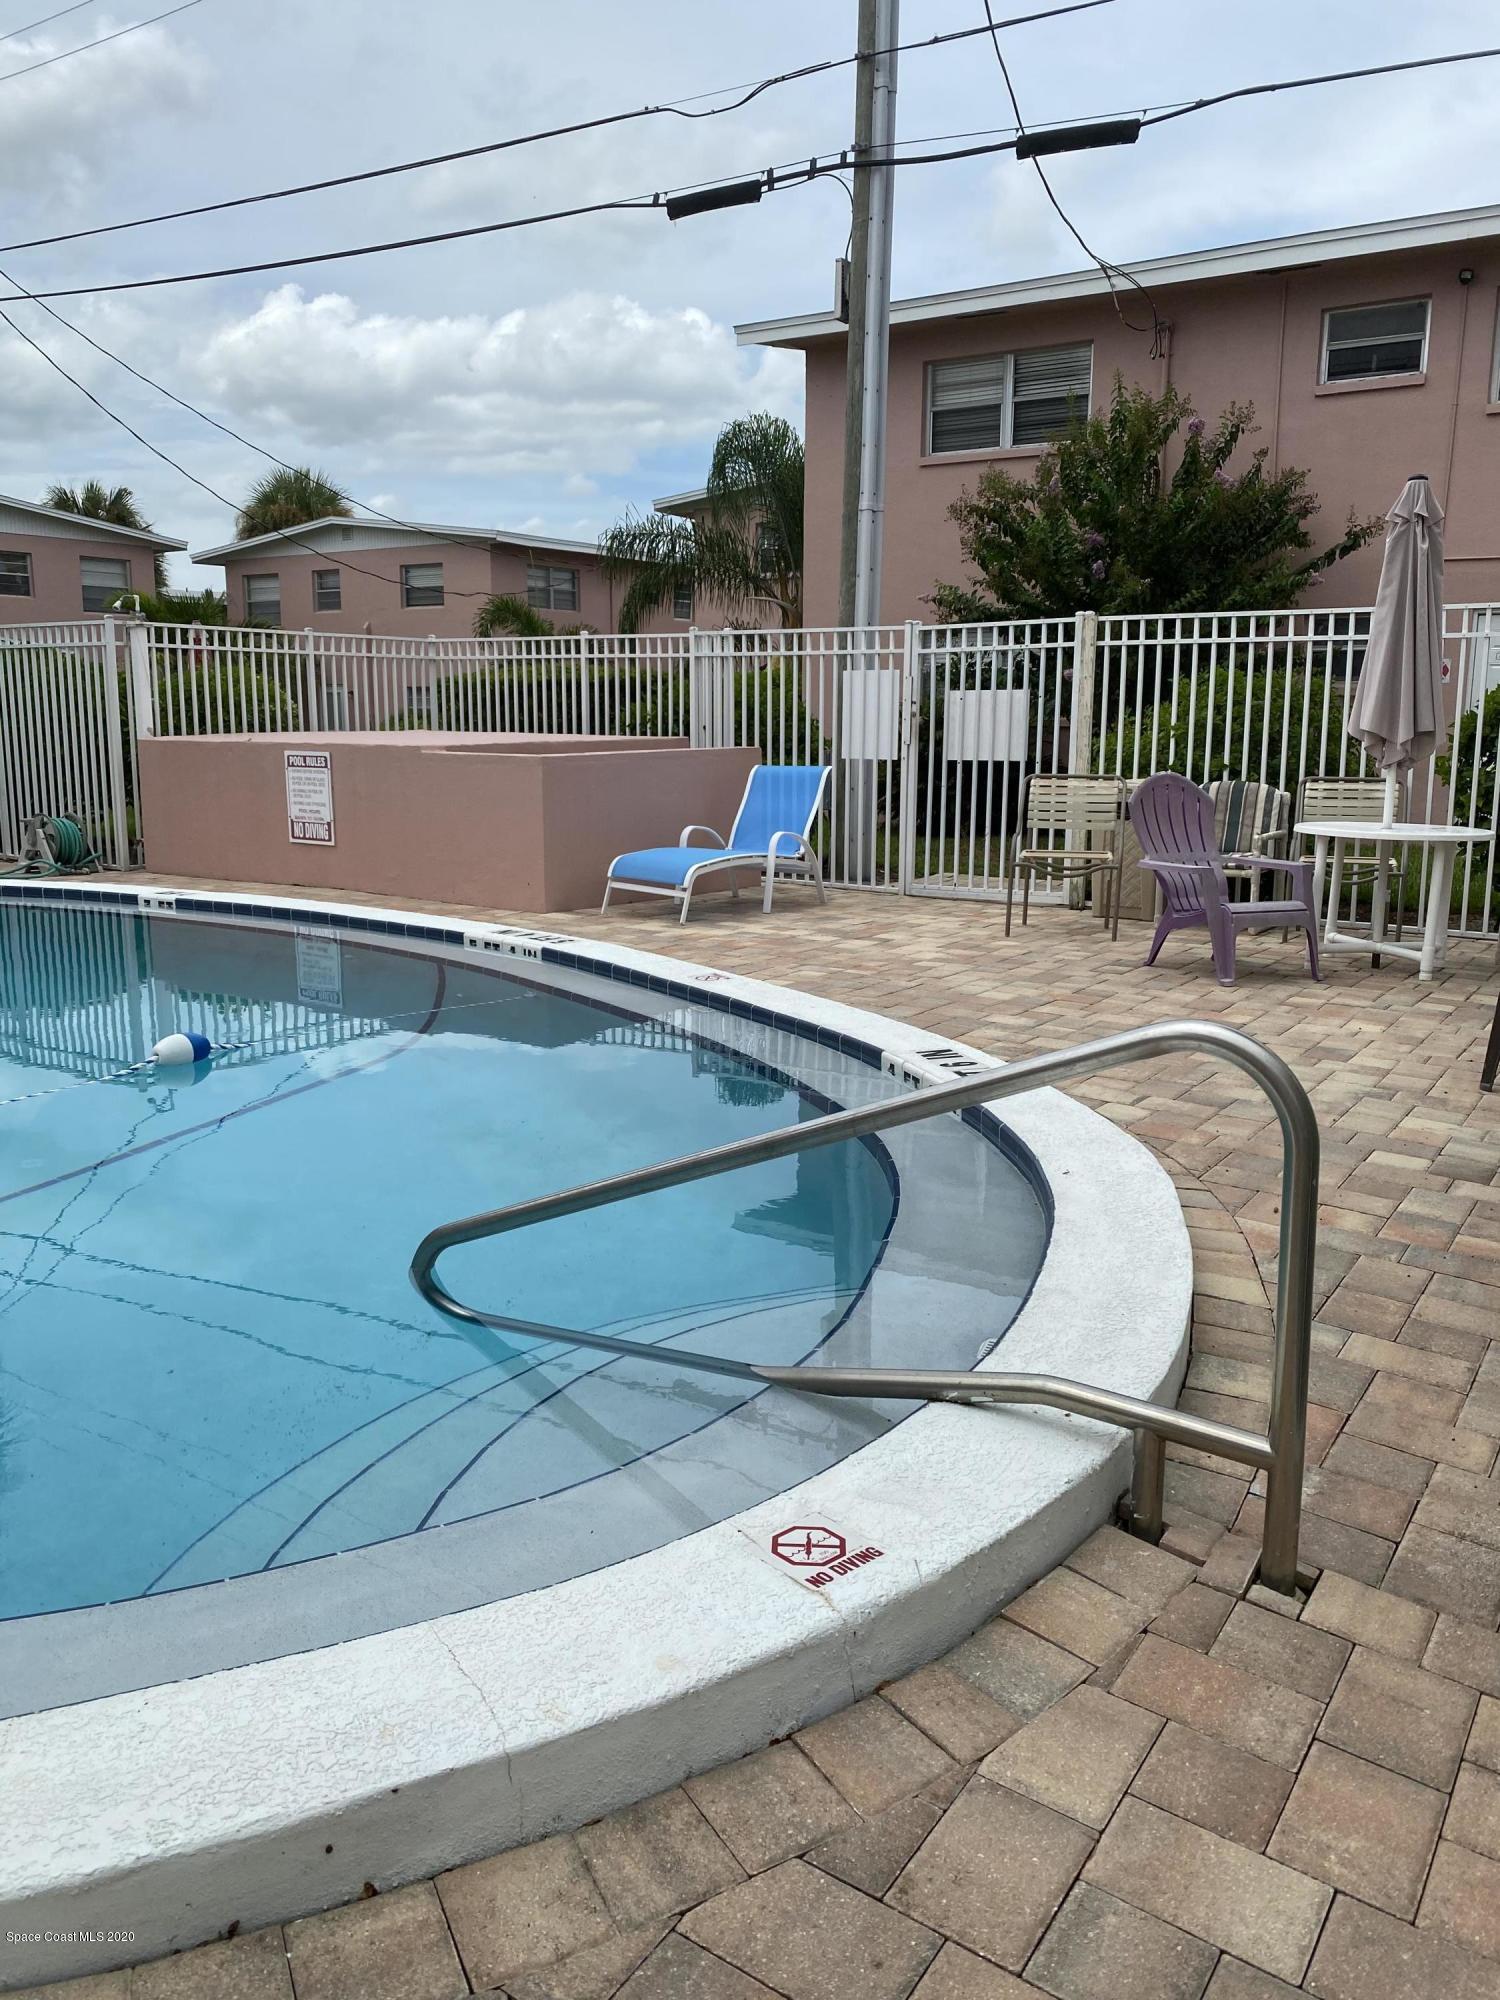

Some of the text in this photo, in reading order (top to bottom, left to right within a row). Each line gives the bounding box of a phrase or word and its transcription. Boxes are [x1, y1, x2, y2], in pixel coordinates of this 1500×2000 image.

[289, 756, 326, 767] POOL RULES
[294, 822, 329, 840] NO DIVING
[484, 941, 501, 951] FT
[508, 945, 516, 954] 4
[523, 948, 538, 958] IN
[916, 1049, 964, 1060] IN
[887, 1063, 921, 1090] 4 FT
[804, 1571, 834, 1589] NO
[828, 1546, 885, 1576] DIVING
